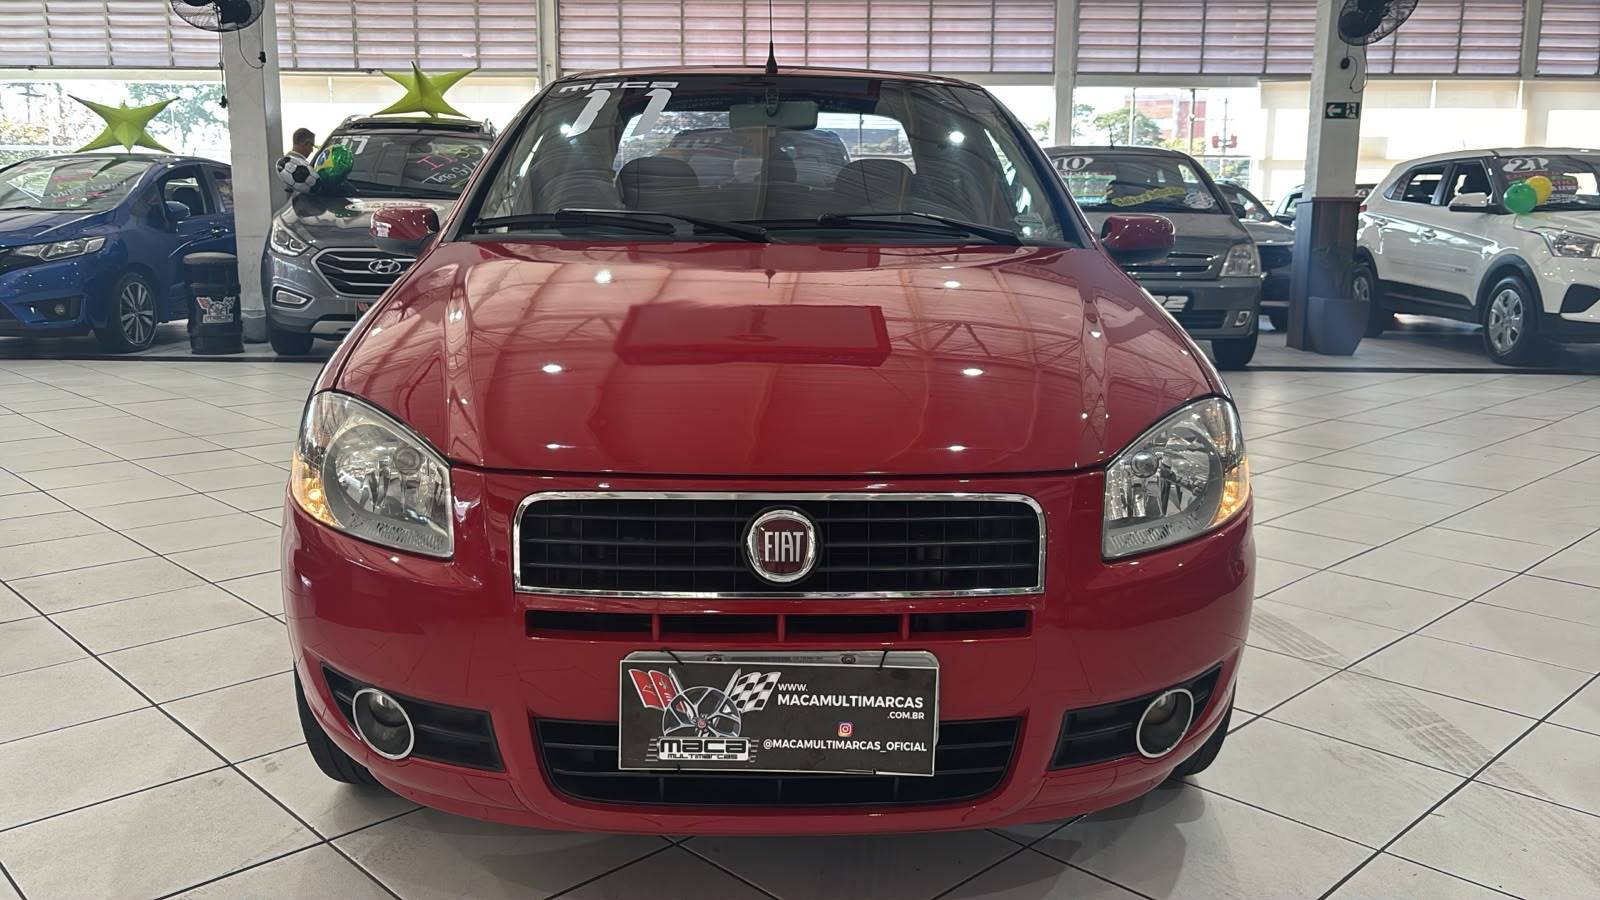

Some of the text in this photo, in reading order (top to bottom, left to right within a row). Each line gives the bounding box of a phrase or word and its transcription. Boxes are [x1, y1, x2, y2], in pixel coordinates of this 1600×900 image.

[565, 89, 672, 137] 11
[1055, 151, 1087, 167] 10
[1508, 157, 1547, 172] 21
[764, 531, 804, 562] FIAT
[777, 683, 808, 692] WWW.
[777, 694, 924, 709] MACAMULTIMARCAS
[887, 711, 925, 720] .COM.BR
[763, 738, 928, 753] @MACAMULTIMARCAS_OFICIAL
